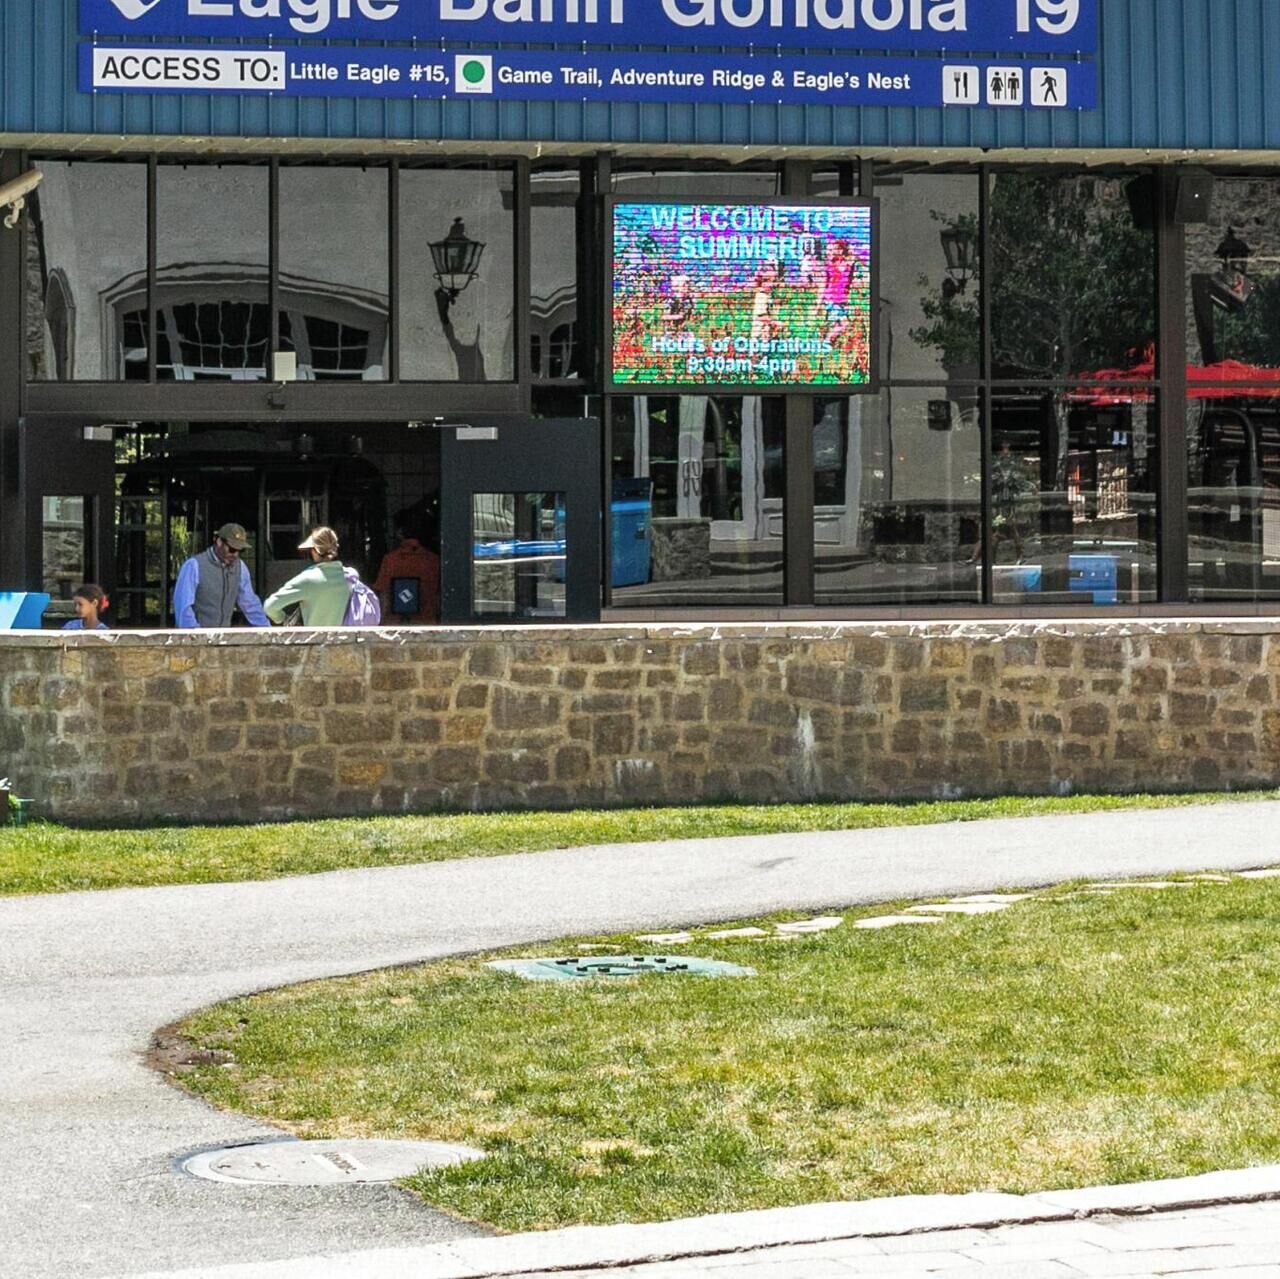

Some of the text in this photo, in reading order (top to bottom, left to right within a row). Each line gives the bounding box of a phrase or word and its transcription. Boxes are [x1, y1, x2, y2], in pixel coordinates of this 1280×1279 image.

[101, 55, 911, 92] ACCESS TO: Little Eagle #15, Game Trail, Adventure Ridge & Eagle's Nest
[651, 206, 833, 232] WELCOME TO
[651, 336, 706, 354] Hours
[733, 337, 833, 355] Operations
